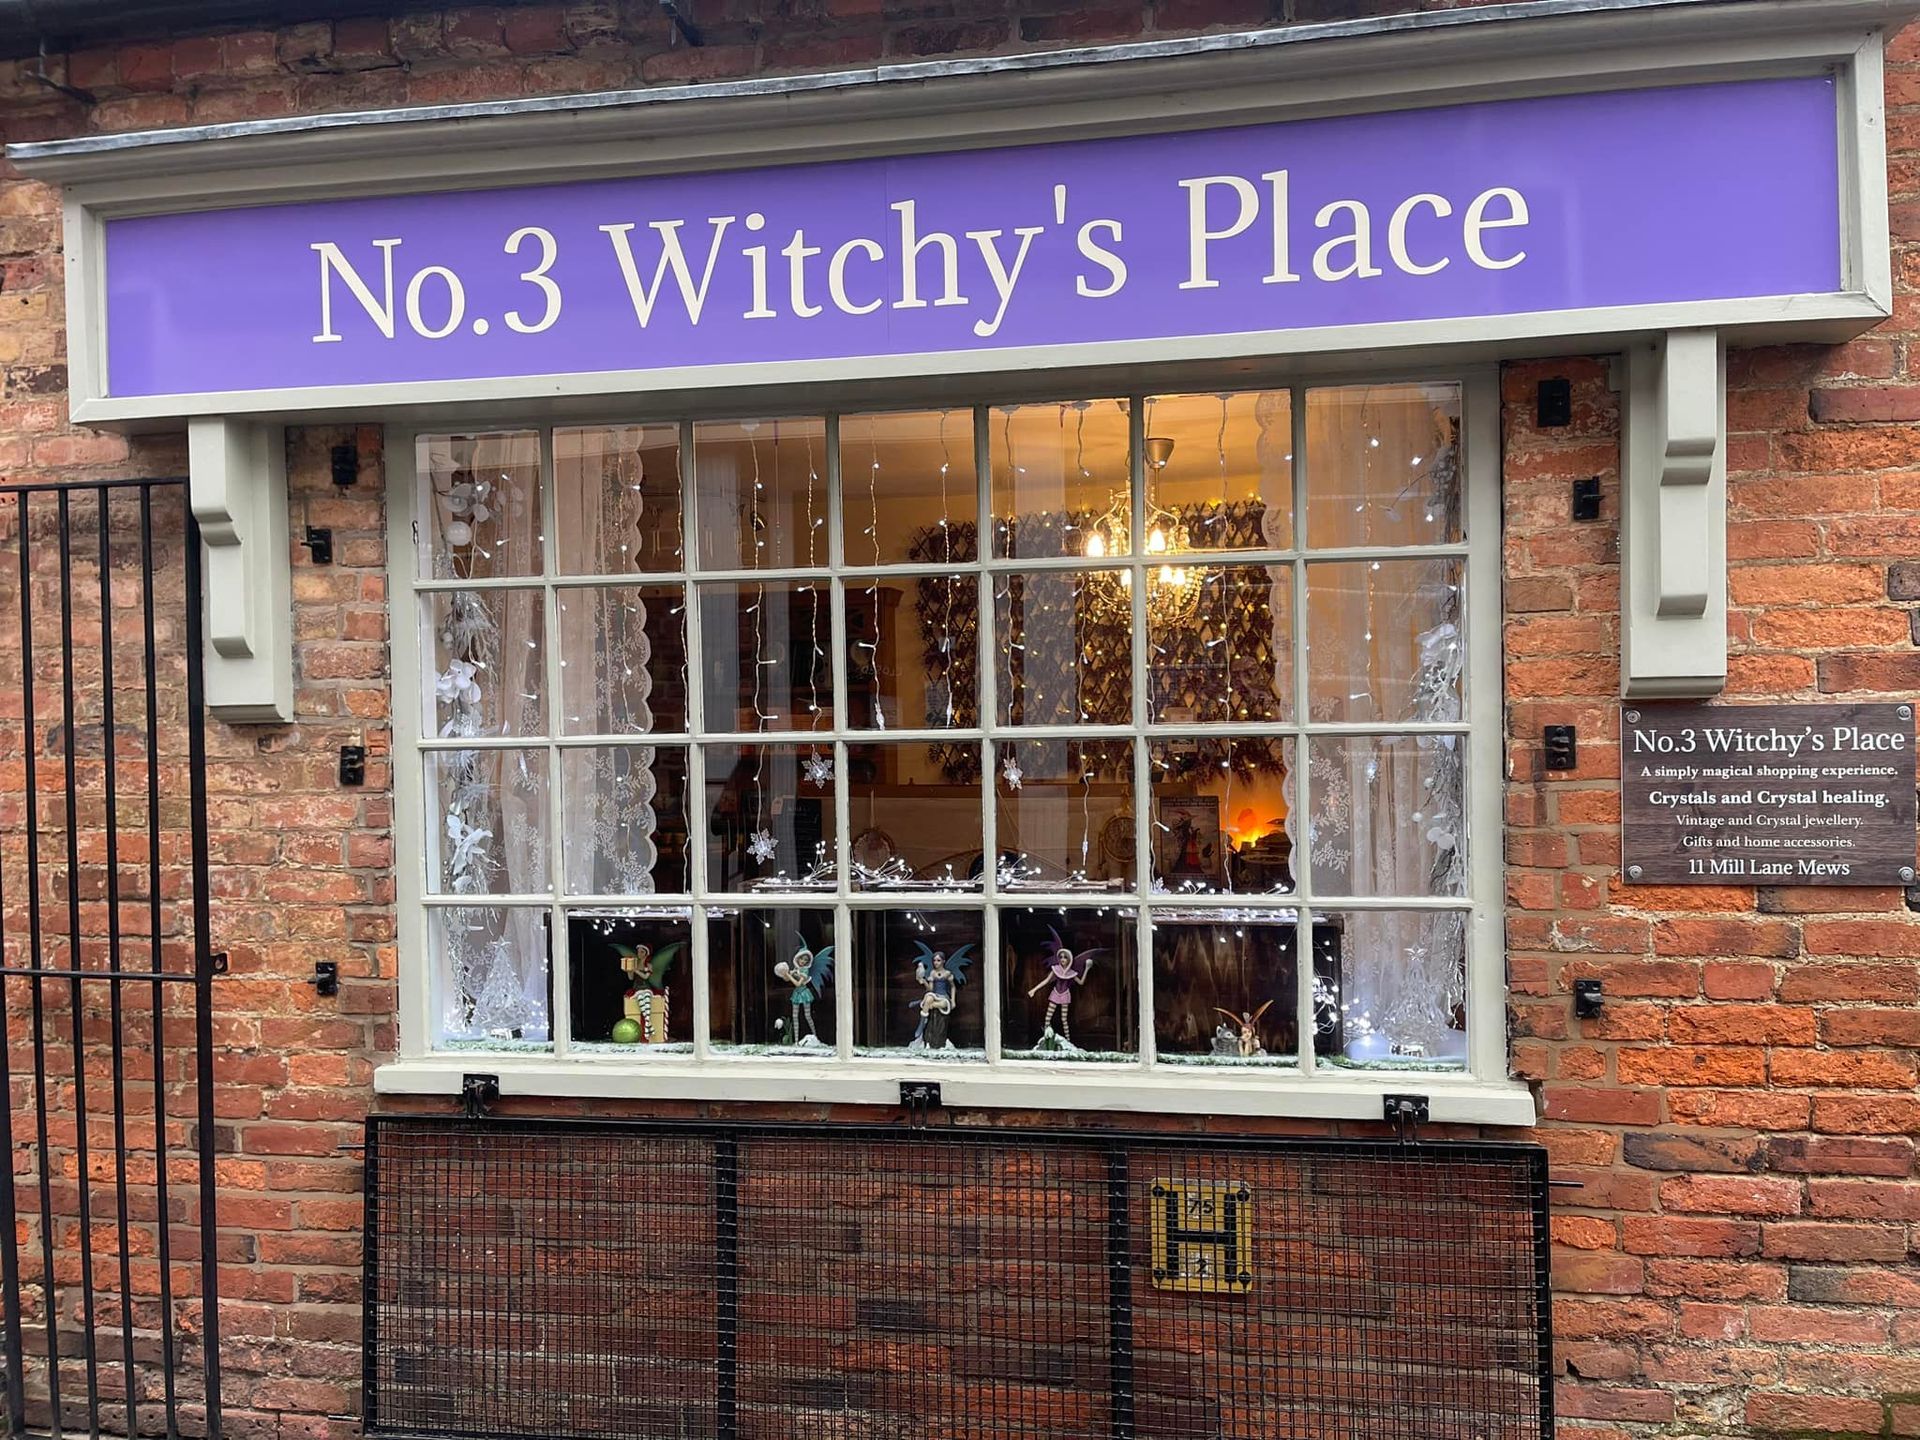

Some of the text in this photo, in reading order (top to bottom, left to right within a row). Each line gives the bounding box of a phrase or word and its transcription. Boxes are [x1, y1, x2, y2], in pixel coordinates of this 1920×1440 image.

[310, 169, 1530, 343] No.3 Witchy's Place
[1633, 729, 1696, 753] No.3
[1833, 726, 1905, 751] Place
[1640, 764, 1898, 781] A simply magical shopping experience.
[1649, 789, 1890, 808] Crystals and Crystal healing.
[1676, 814, 1864, 828] Vintage and Crystal jewellery.
[1683, 835, 1856, 848] Gifts and home accessories.
[1689, 858, 1851, 876] 11 Mill Lane Mews
[1187, 1197, 1214, 1214] 75
[1165, 1190, 1237, 1283] H
